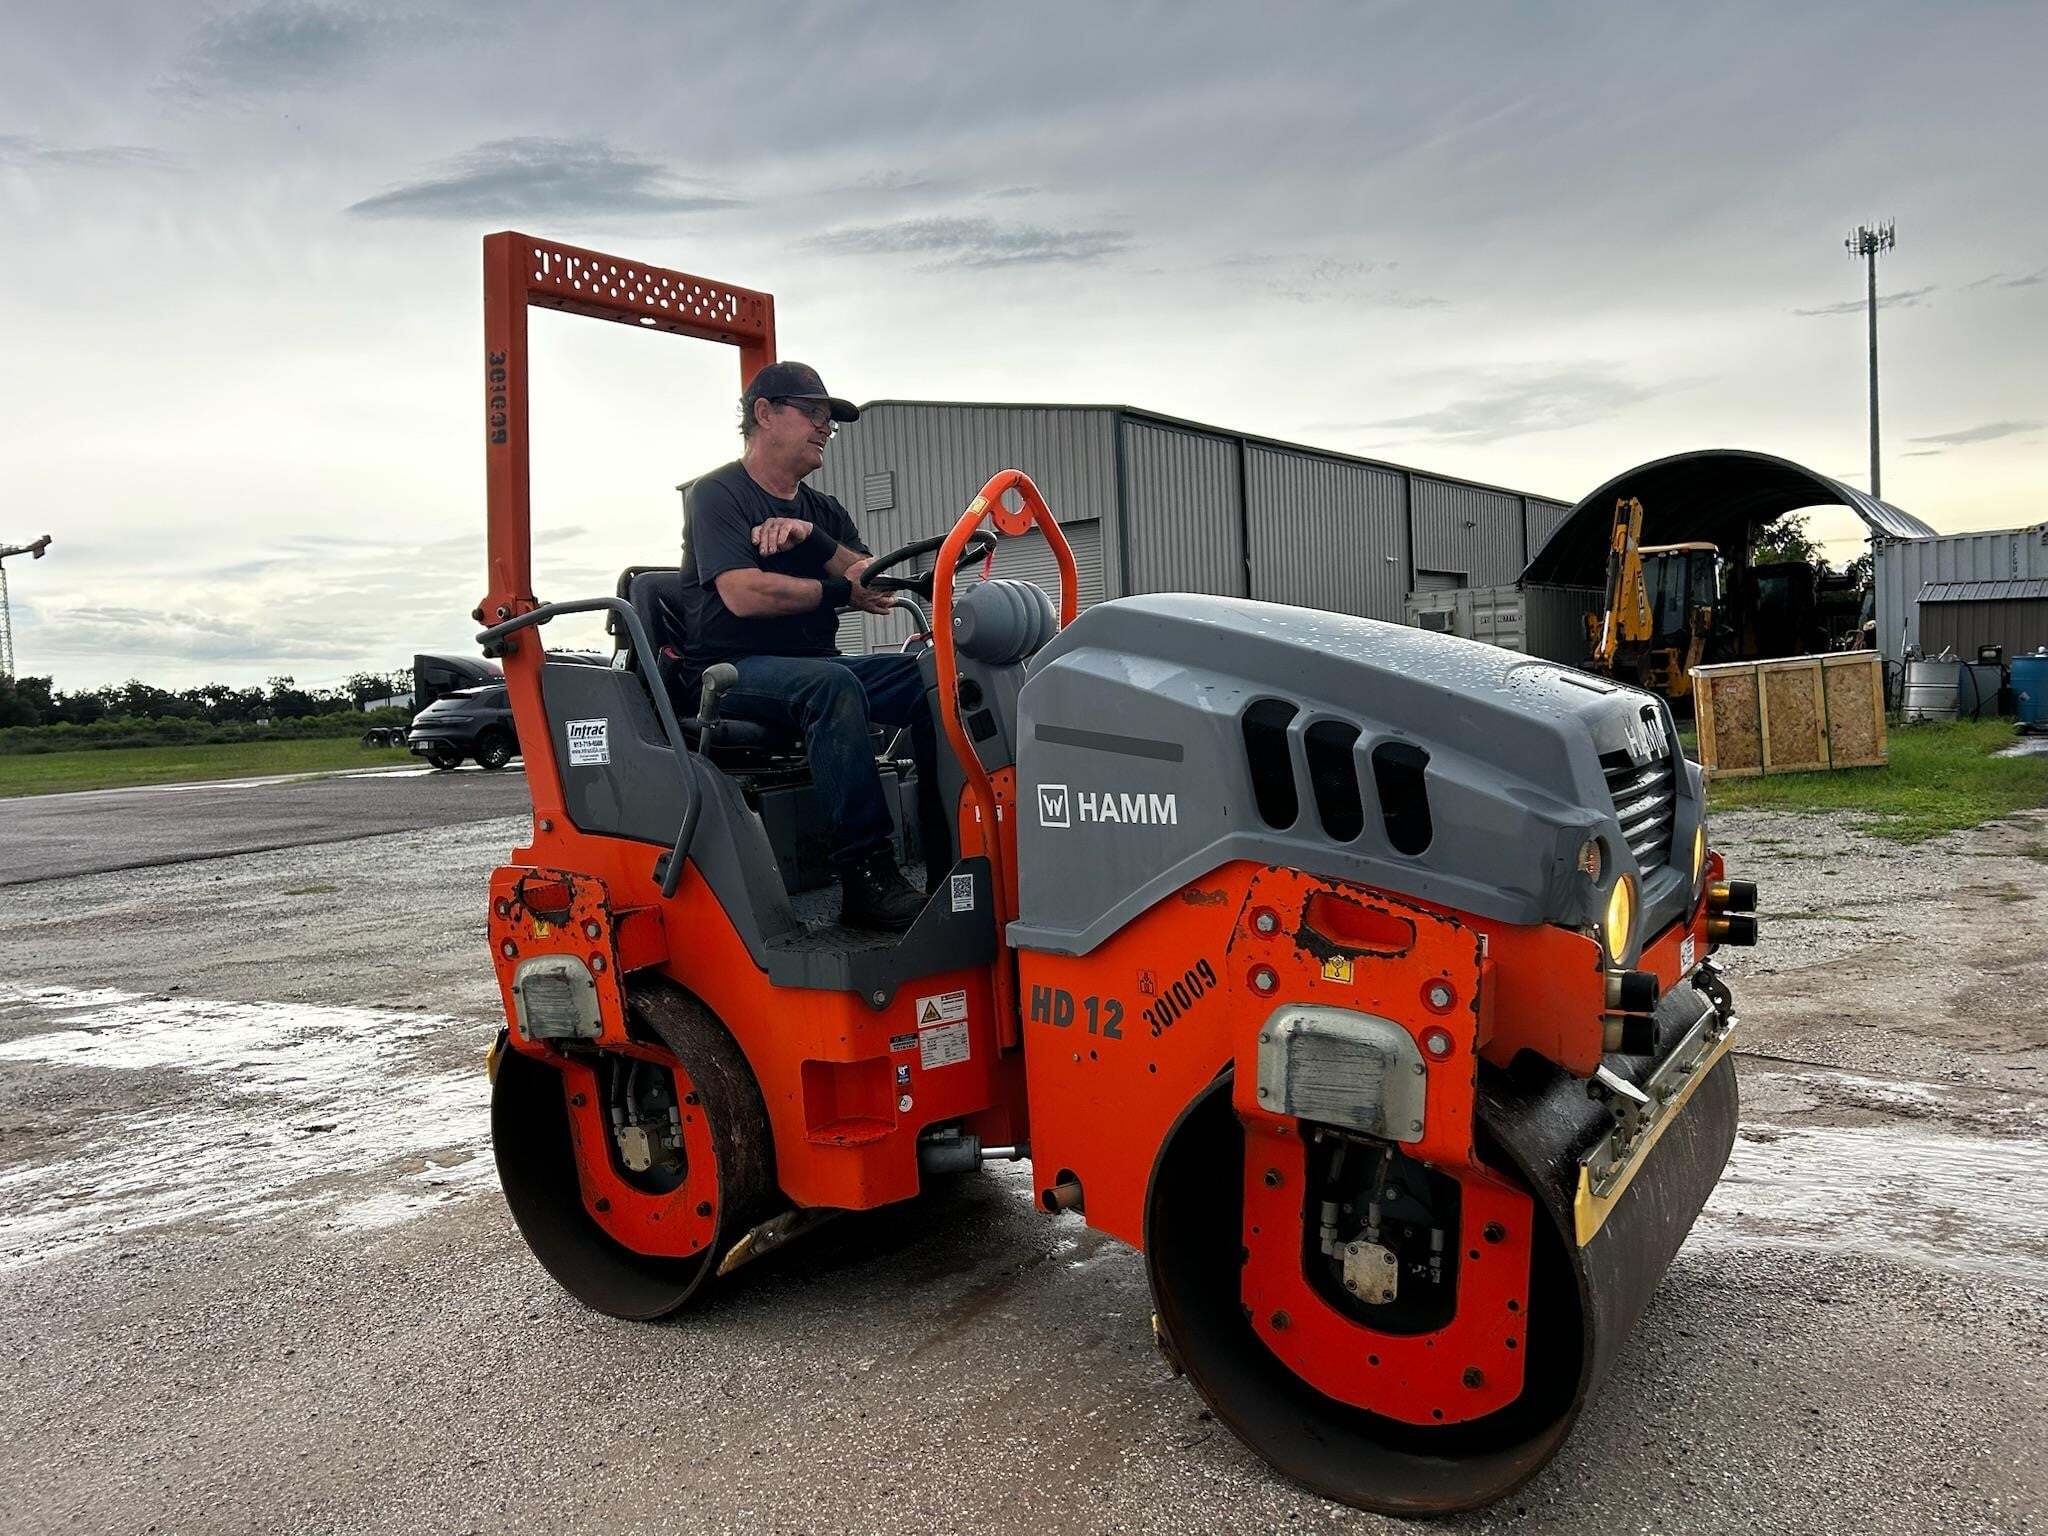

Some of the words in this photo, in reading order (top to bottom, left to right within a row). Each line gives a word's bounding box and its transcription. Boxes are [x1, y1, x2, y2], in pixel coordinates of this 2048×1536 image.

[570, 724, 605, 739] Infrac
[1077, 792, 1178, 825] HAMM
[1030, 984, 1075, 1029] HD
[1083, 996, 1125, 1040] 12
[1142, 958, 1217, 1037] 301009
